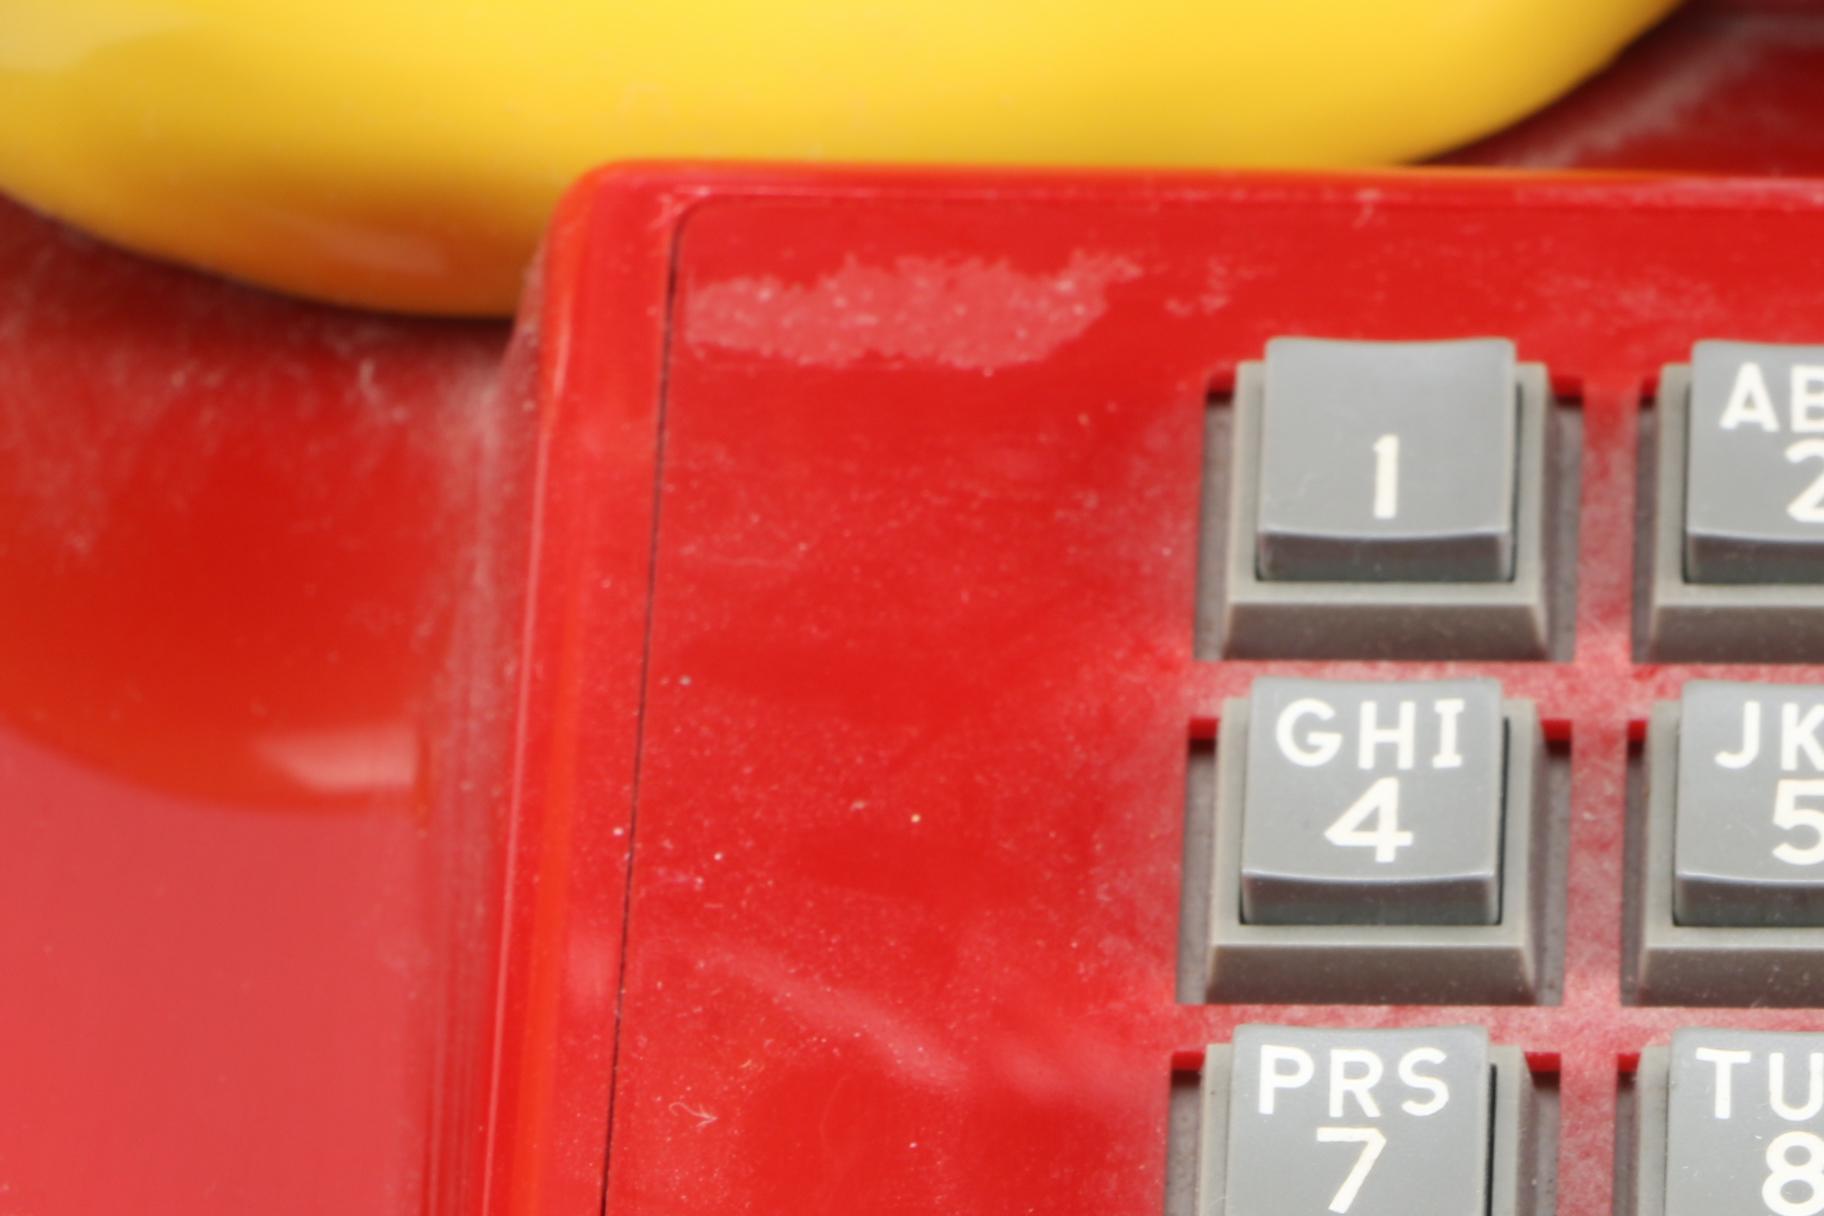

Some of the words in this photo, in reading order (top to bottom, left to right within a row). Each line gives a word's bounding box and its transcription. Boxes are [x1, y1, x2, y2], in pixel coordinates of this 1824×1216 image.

[1372, 434, 1400, 521] 1
[1274, 697, 1466, 771] GHI
[1323, 776, 1415, 864] 4
[1257, 1043, 1451, 1119] PRS
[1314, 1126, 1388, 1215] 7
